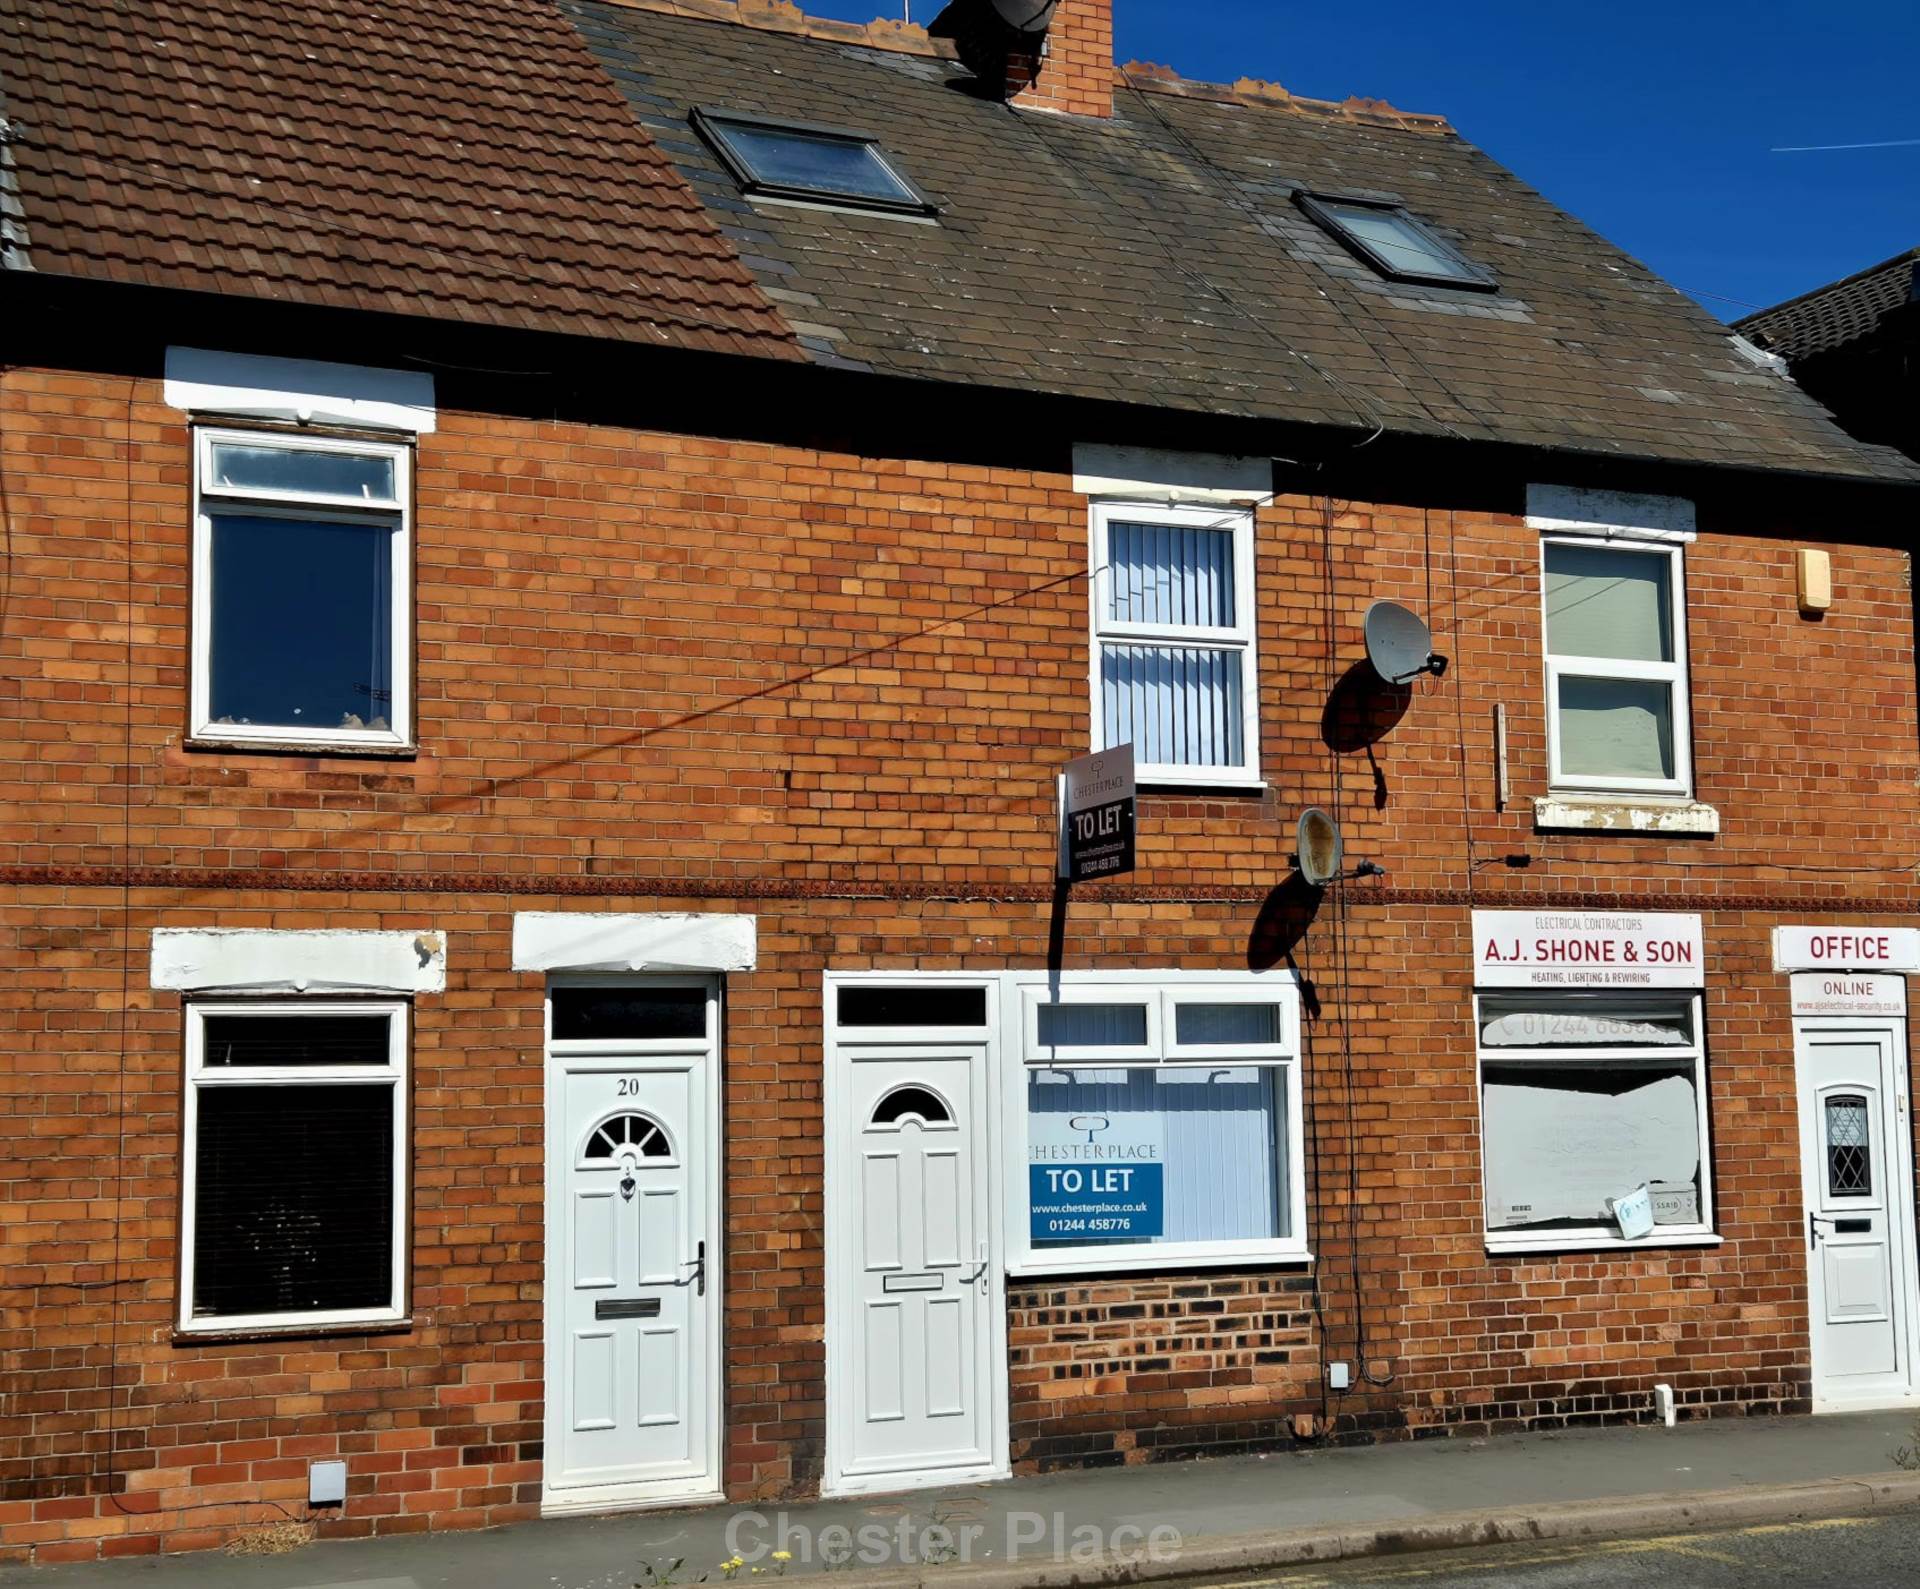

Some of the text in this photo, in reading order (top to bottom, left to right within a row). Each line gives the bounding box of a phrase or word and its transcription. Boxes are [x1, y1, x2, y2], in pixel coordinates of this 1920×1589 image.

[1075, 804, 1122, 840] TO LET
[1535, 916, 1643, 931] ELECTRICAL CONTRACTORS
[1485, 939, 1692, 963] A.J. SHONE & SON
[1810, 936, 1889, 959] OFFICE
[1531, 972, 1651, 984] HEATING, LIGHTING & REWIRING
[1824, 981, 1874, 996] ONLINE
[1523, 1014, 1588, 1035] 01244
[617, 1078, 640, 1097] 20
[1108, 1144, 1157, 1159] PLACE
[1046, 1169, 1134, 1193] TO LET
[1032, 1202, 1147, 1214] www.chesterplace.co.uk
[1049, 1218, 1130, 1231] 01244 458776
